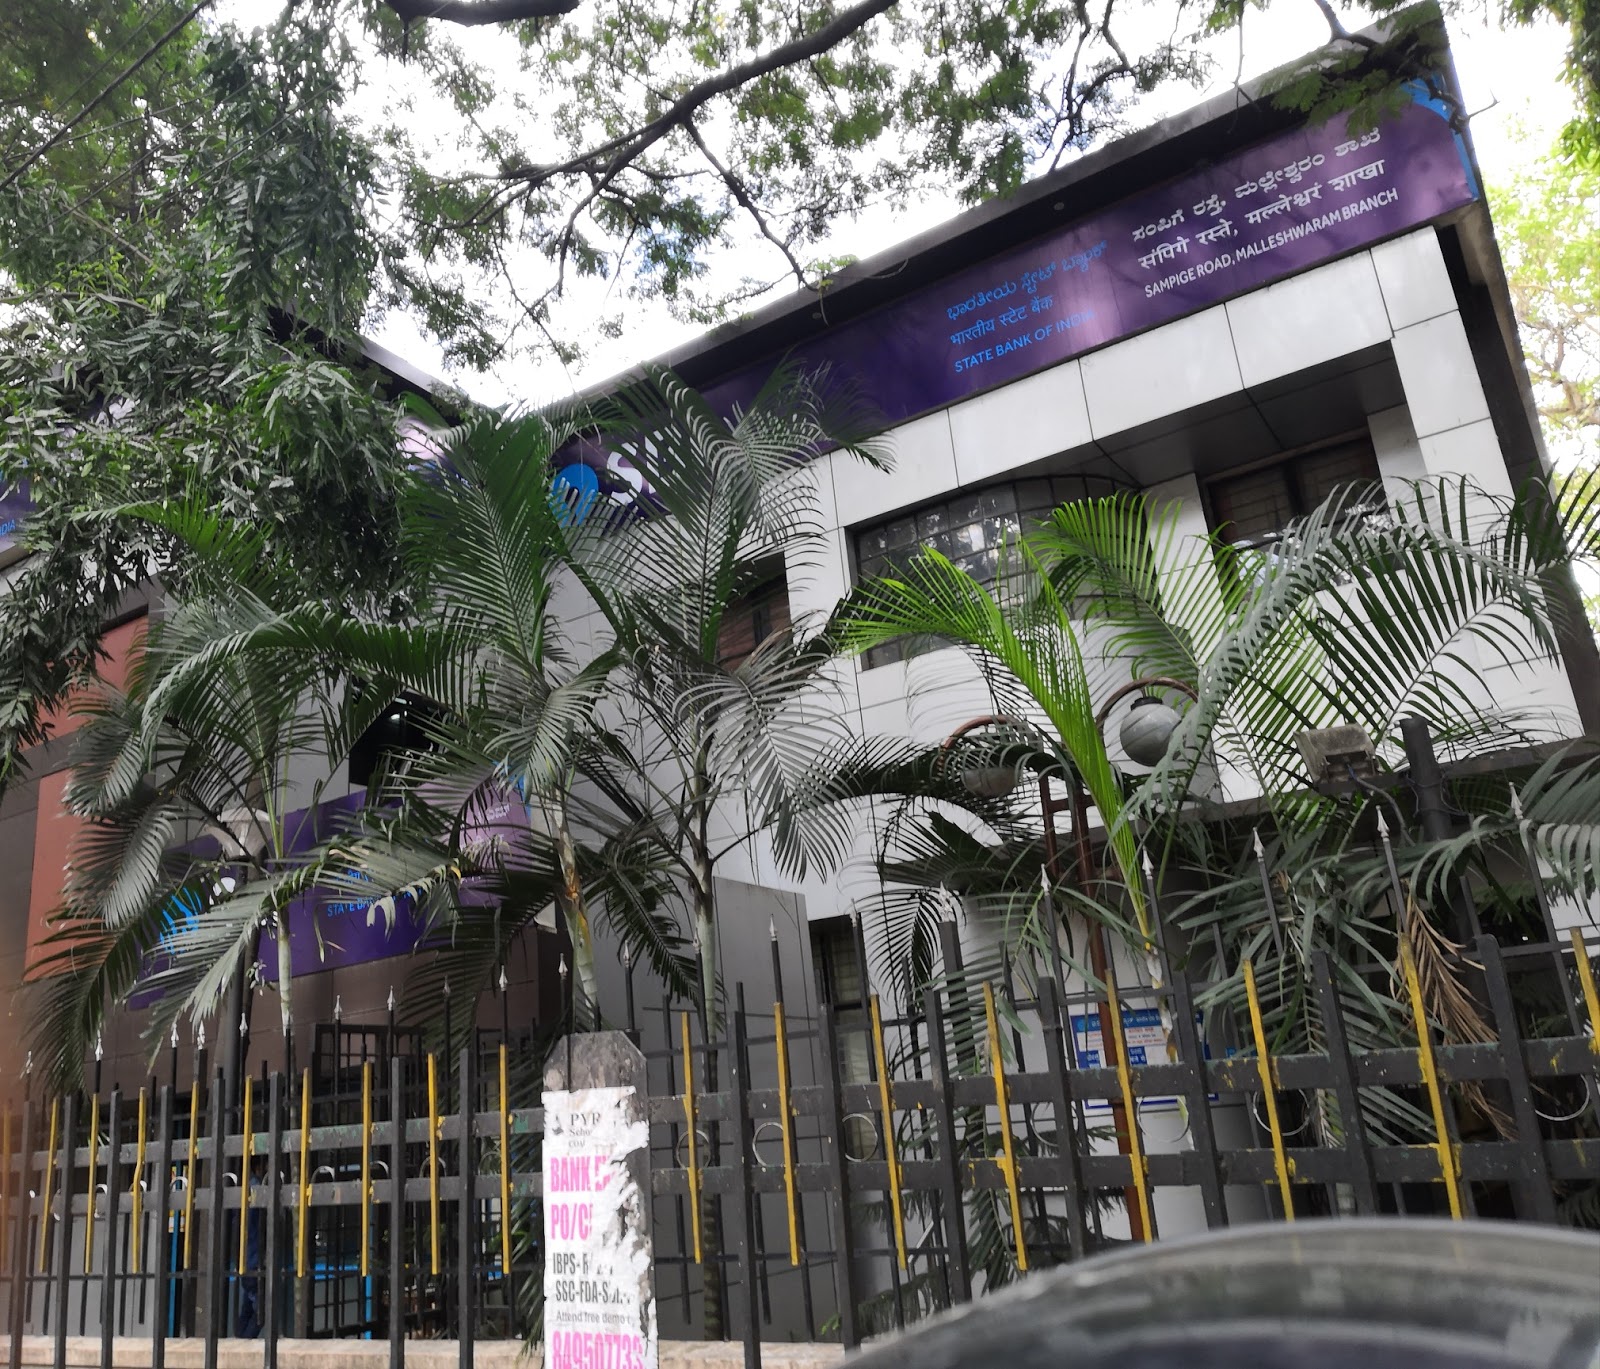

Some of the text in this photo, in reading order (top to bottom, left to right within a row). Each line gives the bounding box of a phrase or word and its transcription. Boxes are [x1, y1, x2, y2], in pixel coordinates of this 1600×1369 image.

[1327, 159, 1386, 191] शाखा
[1132, 209, 1185, 241] ಸಂಪಿಗೆ
[1234, 153, 1326, 199] ಮಲ್ಲೇಶ್ವರಂ
[1144, 187, 1399, 298] SAMPIGE ROAD, MALLESHWARAM BRANCH
[946, 281, 1017, 320] ಭಾರತೀಯ
[950, 295, 1054, 345] भारतीय स्टेट बैंक
[955, 309, 1096, 373] STATE BANK OF INDIA
[0, 519, 16, 536] DIA
[550, 1156, 592, 1192] BANK
[551, 1202, 594, 1241] PO/C
[556, 1310, 583, 1323] Attend
[584, 1311, 600, 1324] free
[602, 1312, 626, 1325] demo
